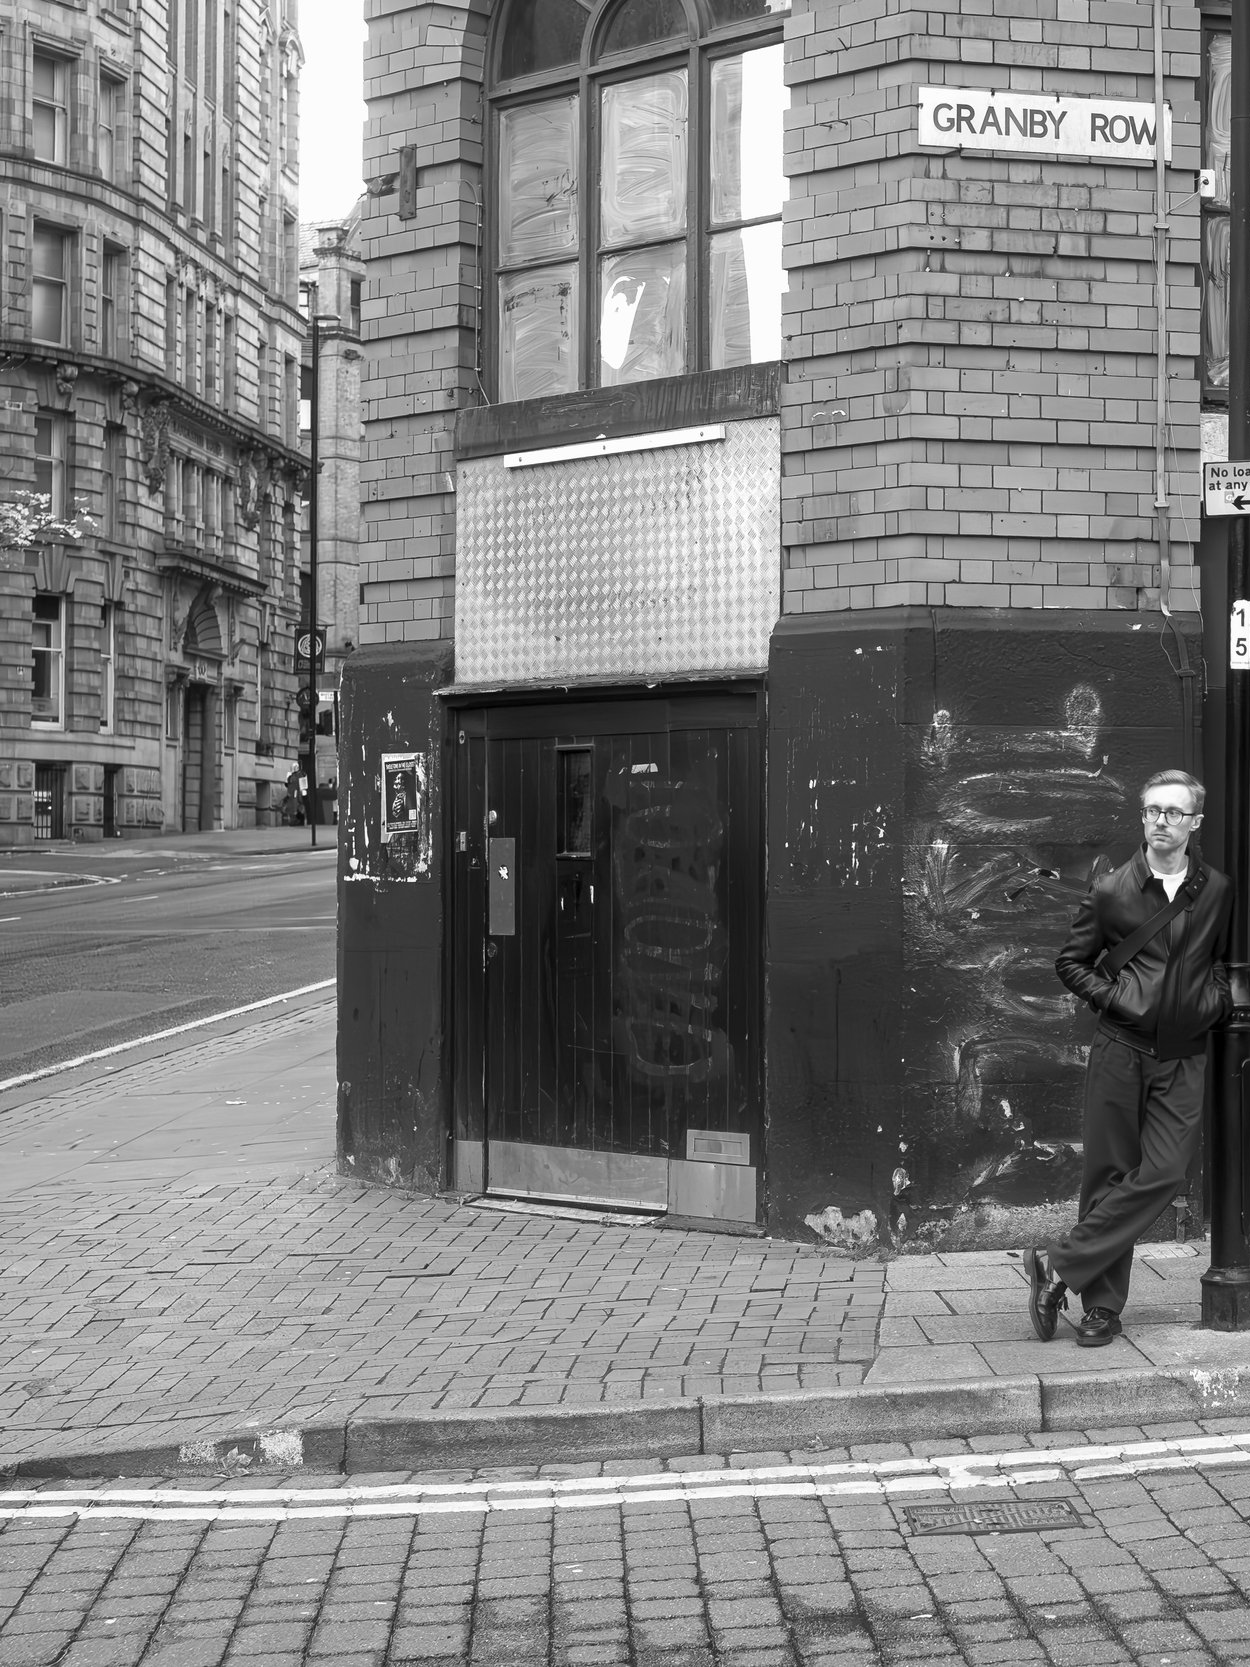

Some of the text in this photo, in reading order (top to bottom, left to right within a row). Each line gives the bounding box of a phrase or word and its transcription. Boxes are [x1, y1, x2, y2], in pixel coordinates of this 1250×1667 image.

[932, 102, 1156, 146] GRANBY ROW
[1210, 467, 1229, 478] No
[1208, 480, 1222, 491] at
[1224, 481, 1248, 492] any
